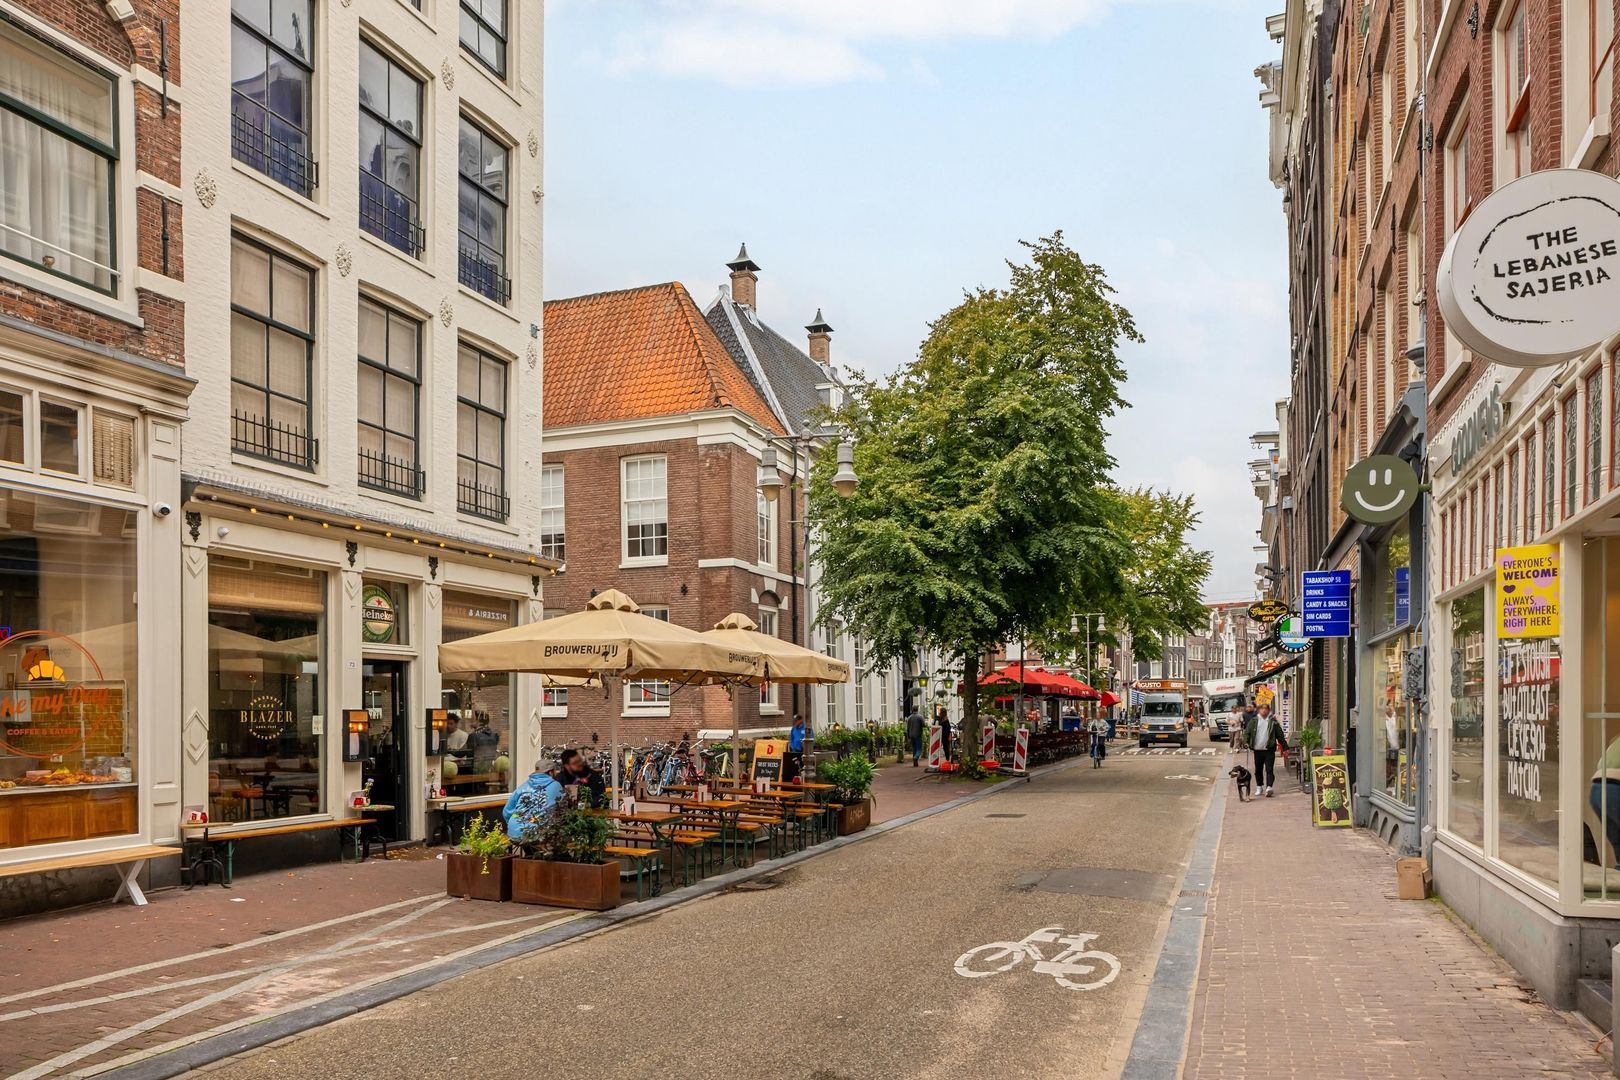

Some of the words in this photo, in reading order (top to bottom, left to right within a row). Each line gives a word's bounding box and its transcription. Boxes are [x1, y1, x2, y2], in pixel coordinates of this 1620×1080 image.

[1526, 226, 1578, 250] THE
[1493, 239, 1618, 278] LEBANESE
[1506, 266, 1611, 299] SAJERIA
[1503, 556, 1552, 570] EVERYONE'S
[1305, 576, 1334, 584] TABAKSHOP
[1503, 567, 1558, 581] WELCOME
[1305, 600, 1322, 608] CANDY
[1503, 595, 1537, 606] ALWAYS,
[1315, 612, 1332, 620] CARDS
[1503, 604, 1559, 617] EVERYWHERE,
[1503, 617, 1528, 628] RIGHT
[1530, 616, 1551, 626] HERE
[544, 644, 602, 658] BROUWERIJ
[31, 693, 64, 716] my
[240, 710, 293, 723] BLAZER
[7, 728, 41, 736] COFFEE
